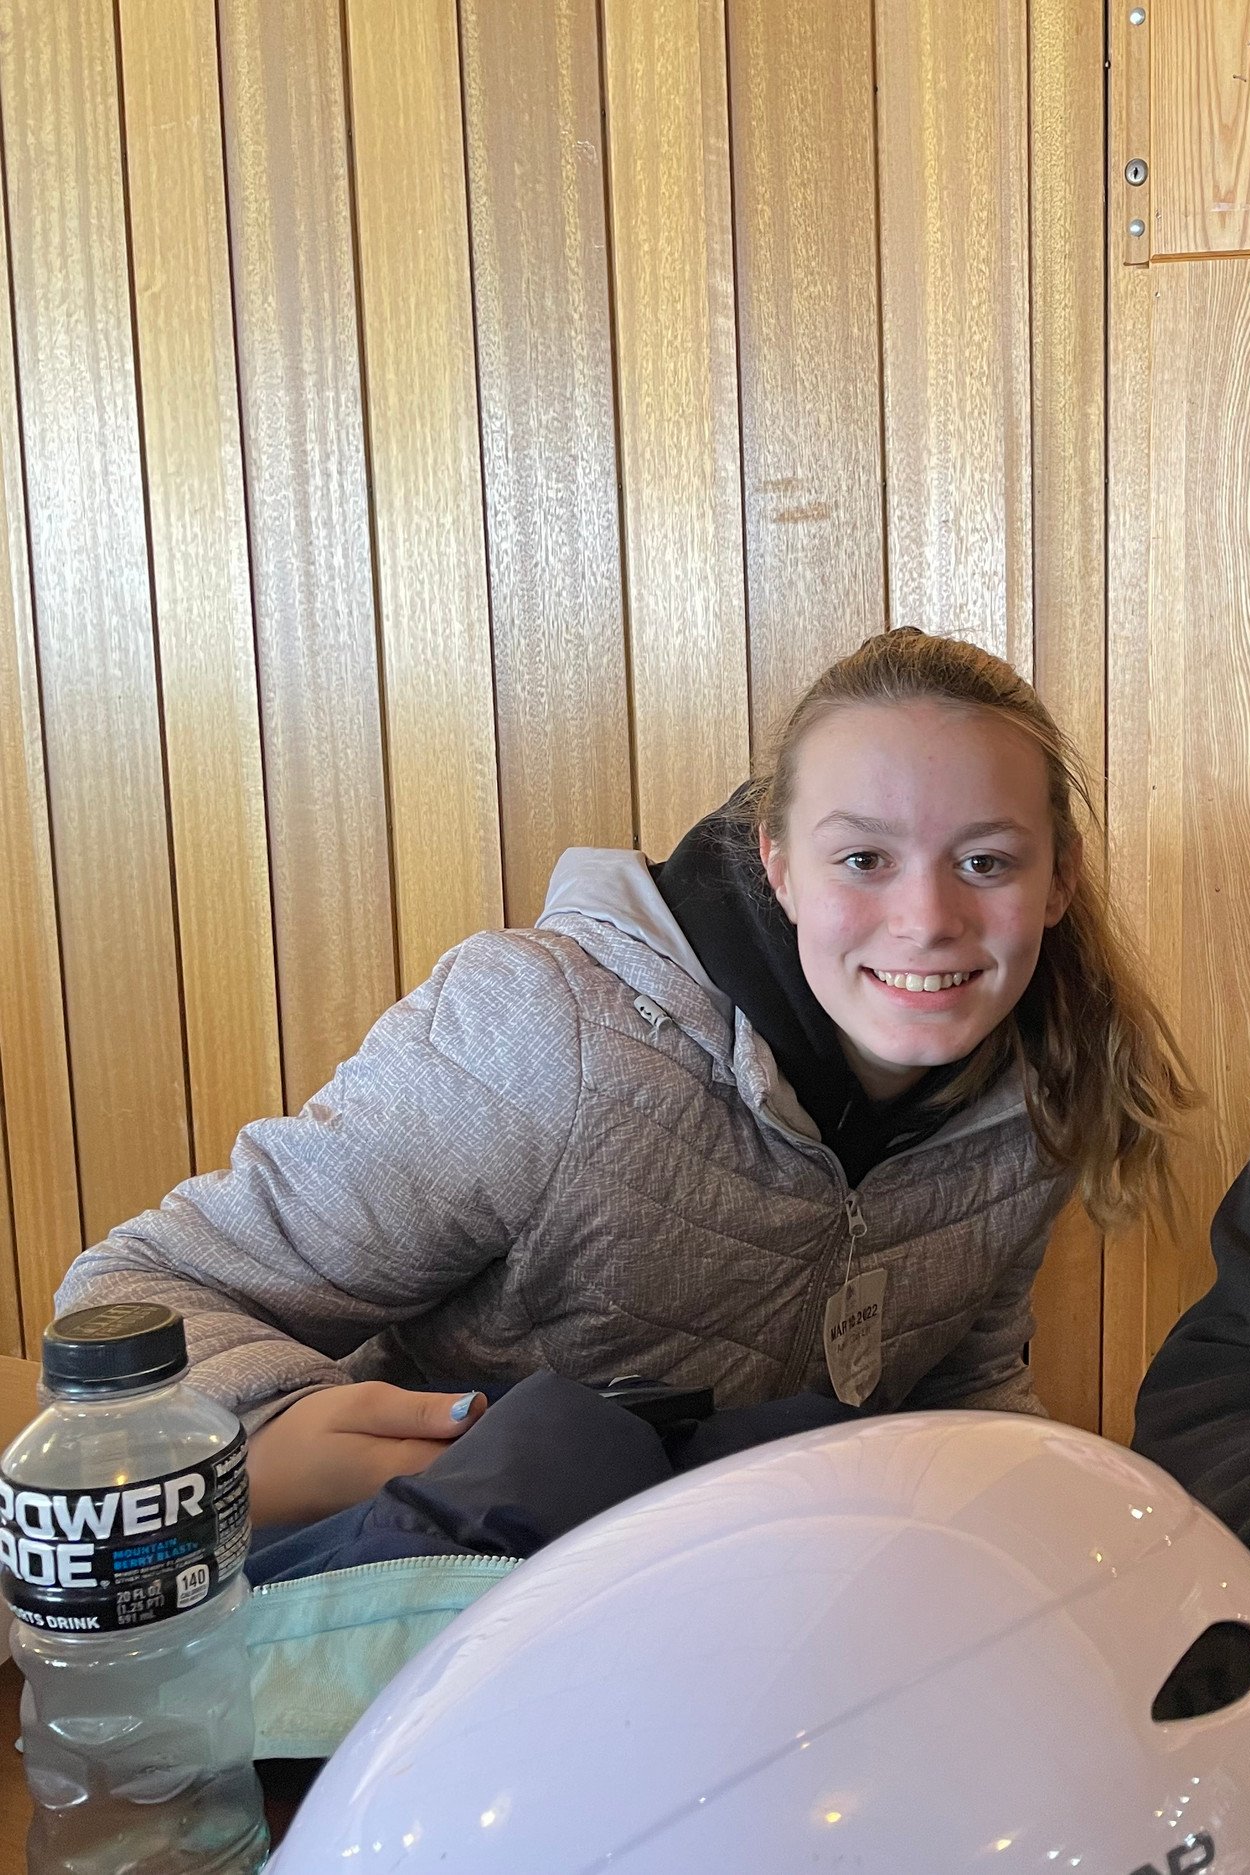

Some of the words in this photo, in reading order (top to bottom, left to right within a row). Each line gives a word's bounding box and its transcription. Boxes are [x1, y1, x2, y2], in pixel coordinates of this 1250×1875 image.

[112, 1537, 177, 1560] MOUNTAIN
[113, 1554, 154, 1571] BERRY
[183, 1568, 206, 1591] 140
[117, 1590, 131, 1604] 20
[133, 1587, 146, 1600] FL
[117, 1601, 144, 1616] (1.25
[46, 1615, 101, 1630] DRINK
